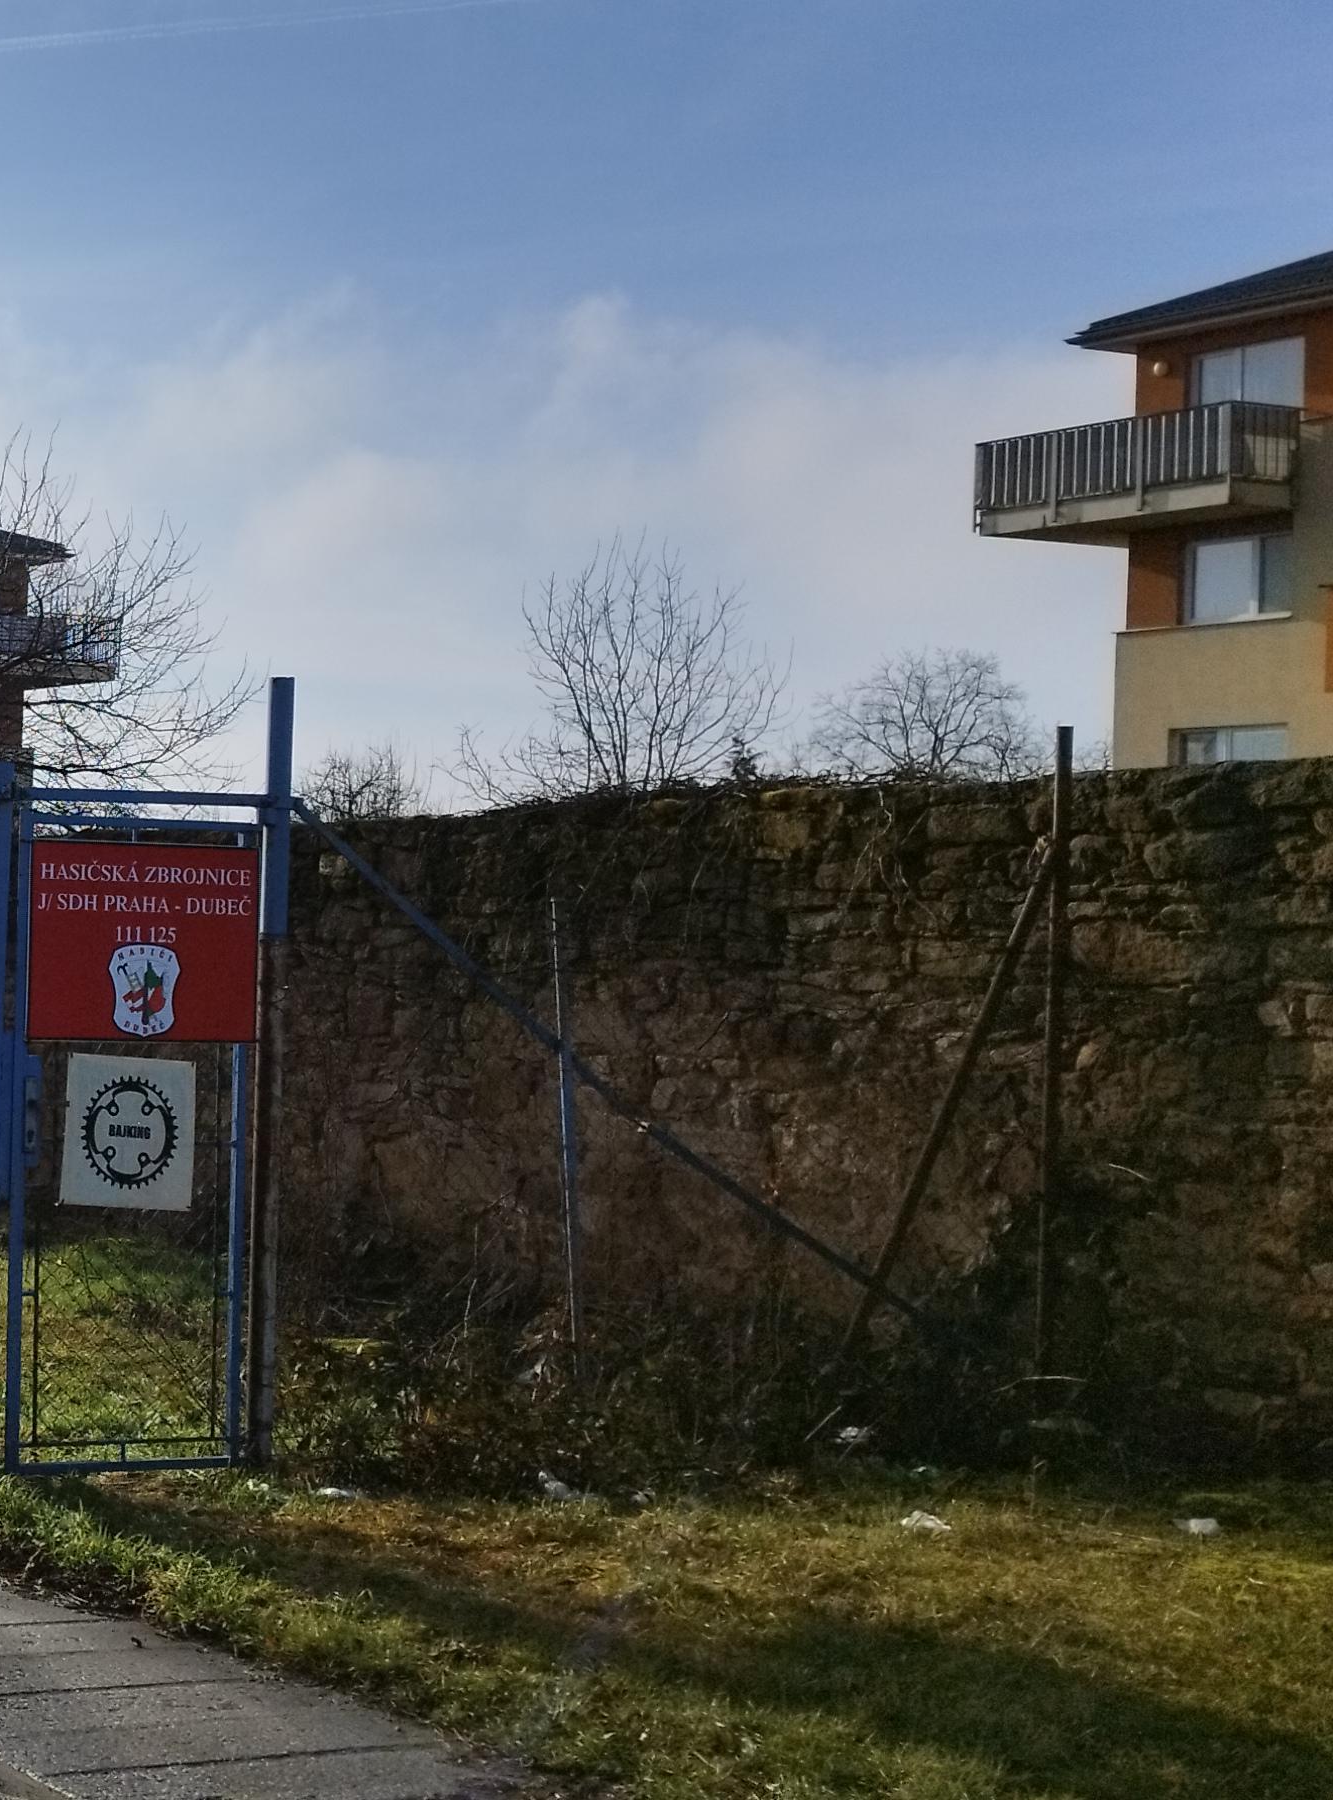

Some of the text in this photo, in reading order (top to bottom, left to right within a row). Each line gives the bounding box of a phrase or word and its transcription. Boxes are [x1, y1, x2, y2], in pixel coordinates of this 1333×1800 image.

[40, 860, 252, 887] HASIČSKÁ ZBROJNICE
[57, 893, 98, 911] SDH
[104, 895, 170, 914] PRAHA
[186, 895, 252, 916] DUBEČ
[149, 926, 177, 944] 125
[108, 1124, 151, 1140] BAJKING
